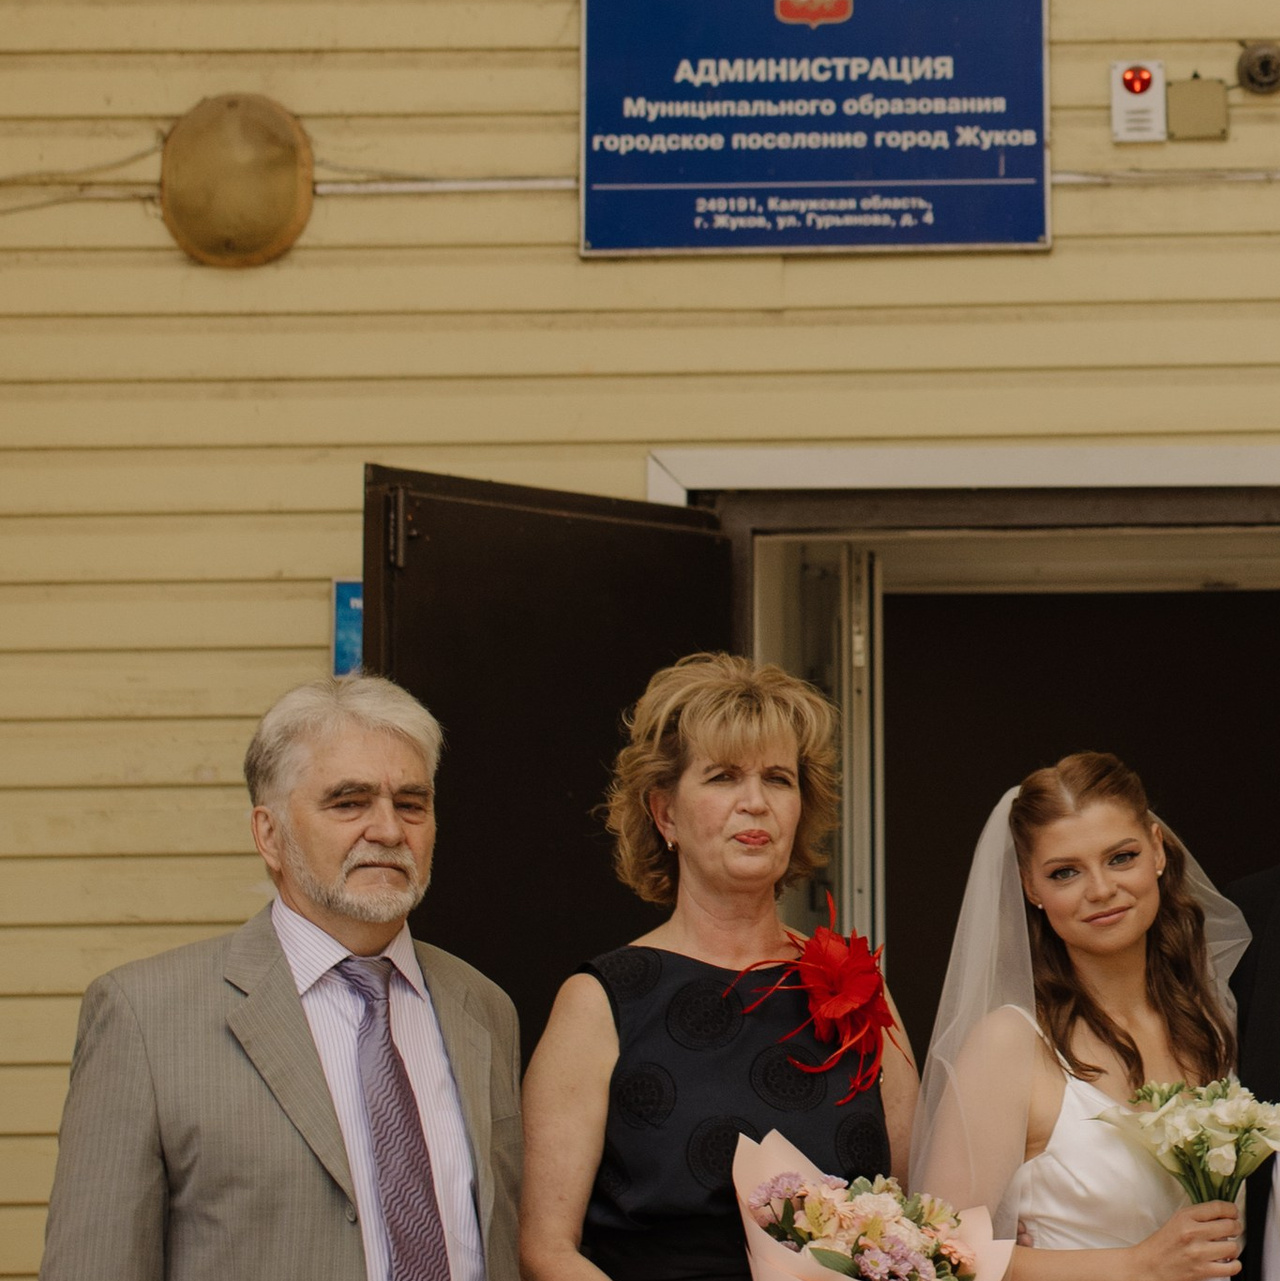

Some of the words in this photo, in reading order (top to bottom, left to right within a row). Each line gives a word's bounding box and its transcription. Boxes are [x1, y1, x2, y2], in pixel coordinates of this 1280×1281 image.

[673, 55, 954, 88] АДМИНИСТРАЦИЯ
[622, 96, 837, 122] Муниципального
[842, 93, 1007, 119] образования
[591, 133, 725, 156] городское
[731, 131, 868, 150] поселение
[873, 129, 950, 152] город
[955, 125, 1037, 149] Жуков
